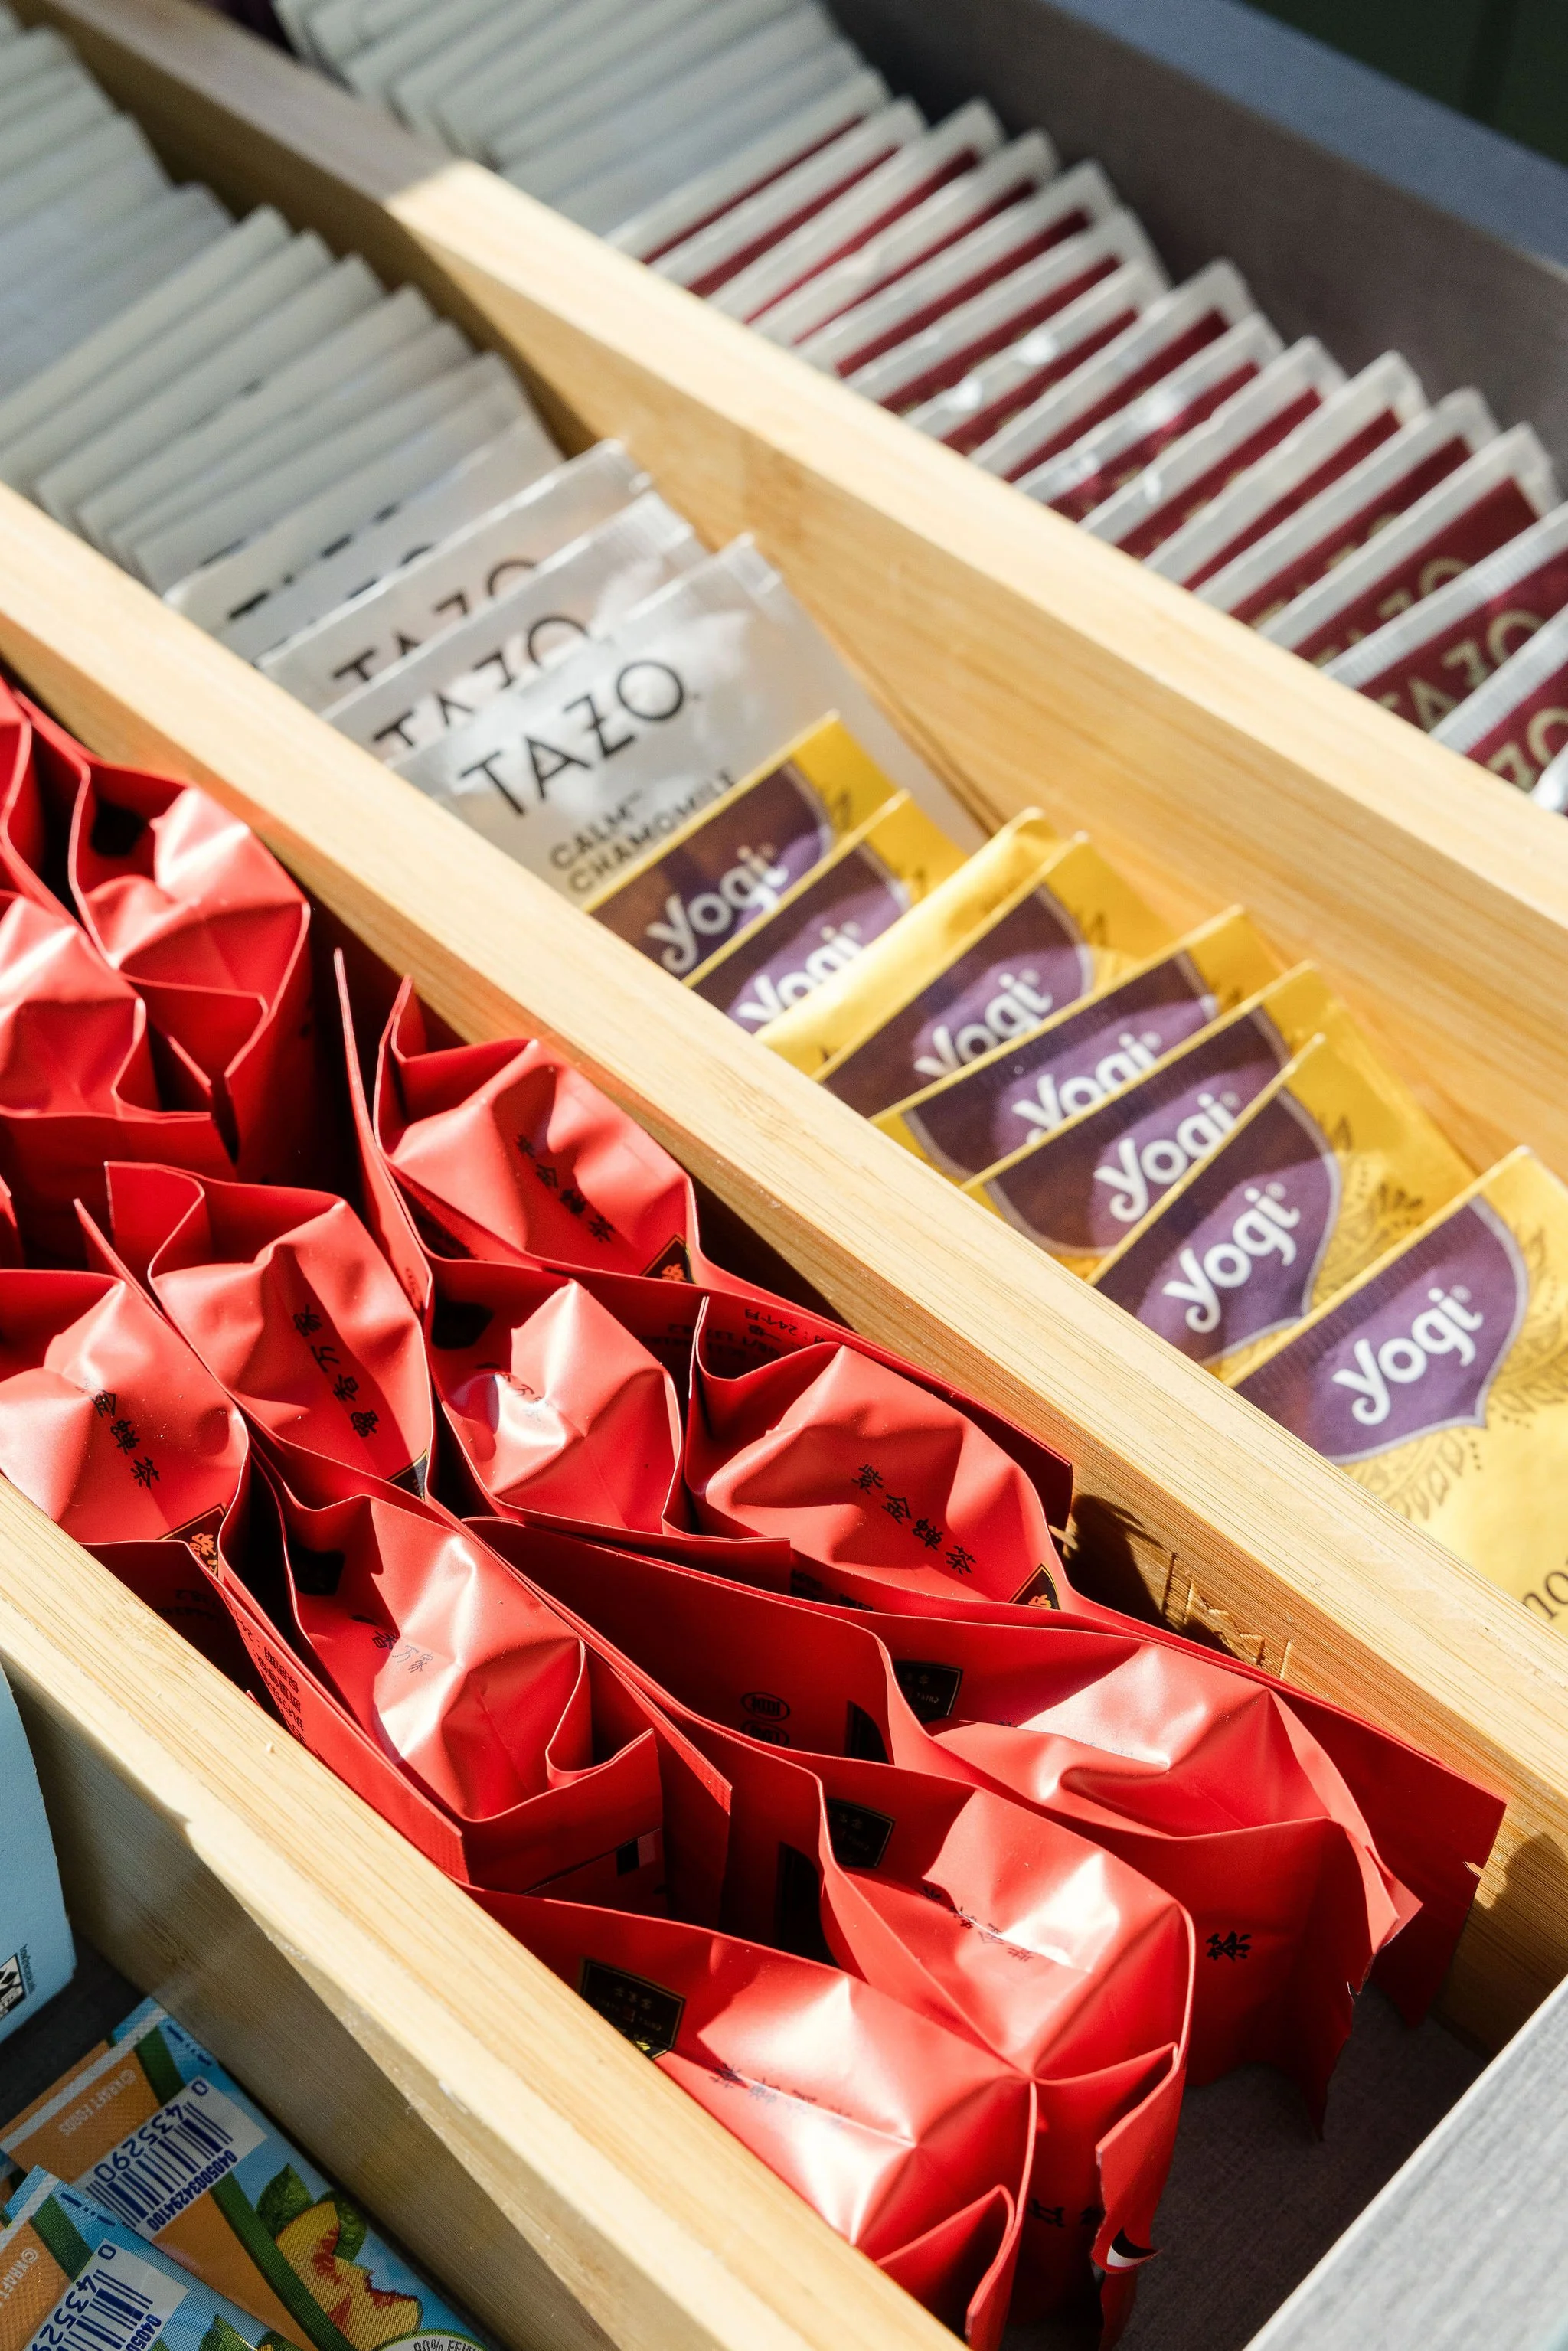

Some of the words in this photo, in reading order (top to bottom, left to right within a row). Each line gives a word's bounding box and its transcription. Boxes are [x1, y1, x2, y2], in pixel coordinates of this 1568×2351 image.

[459, 661, 684, 816] TAZO
[646, 846, 789, 973] yogi
[1162, 1185, 1301, 1334] yogi
[292, 1304, 380, 1438] 蜜香万家
[1336, 1287, 1485, 1425] yogi
[851, 1464, 977, 1575] 紫金蝉茶
[94, 2104, 184, 2182] 435290
[191, 2080, 209, 2097] 0
[146, 2149, 237, 2231] 04050034294100
[97, 2244, 116, 2261] 0
